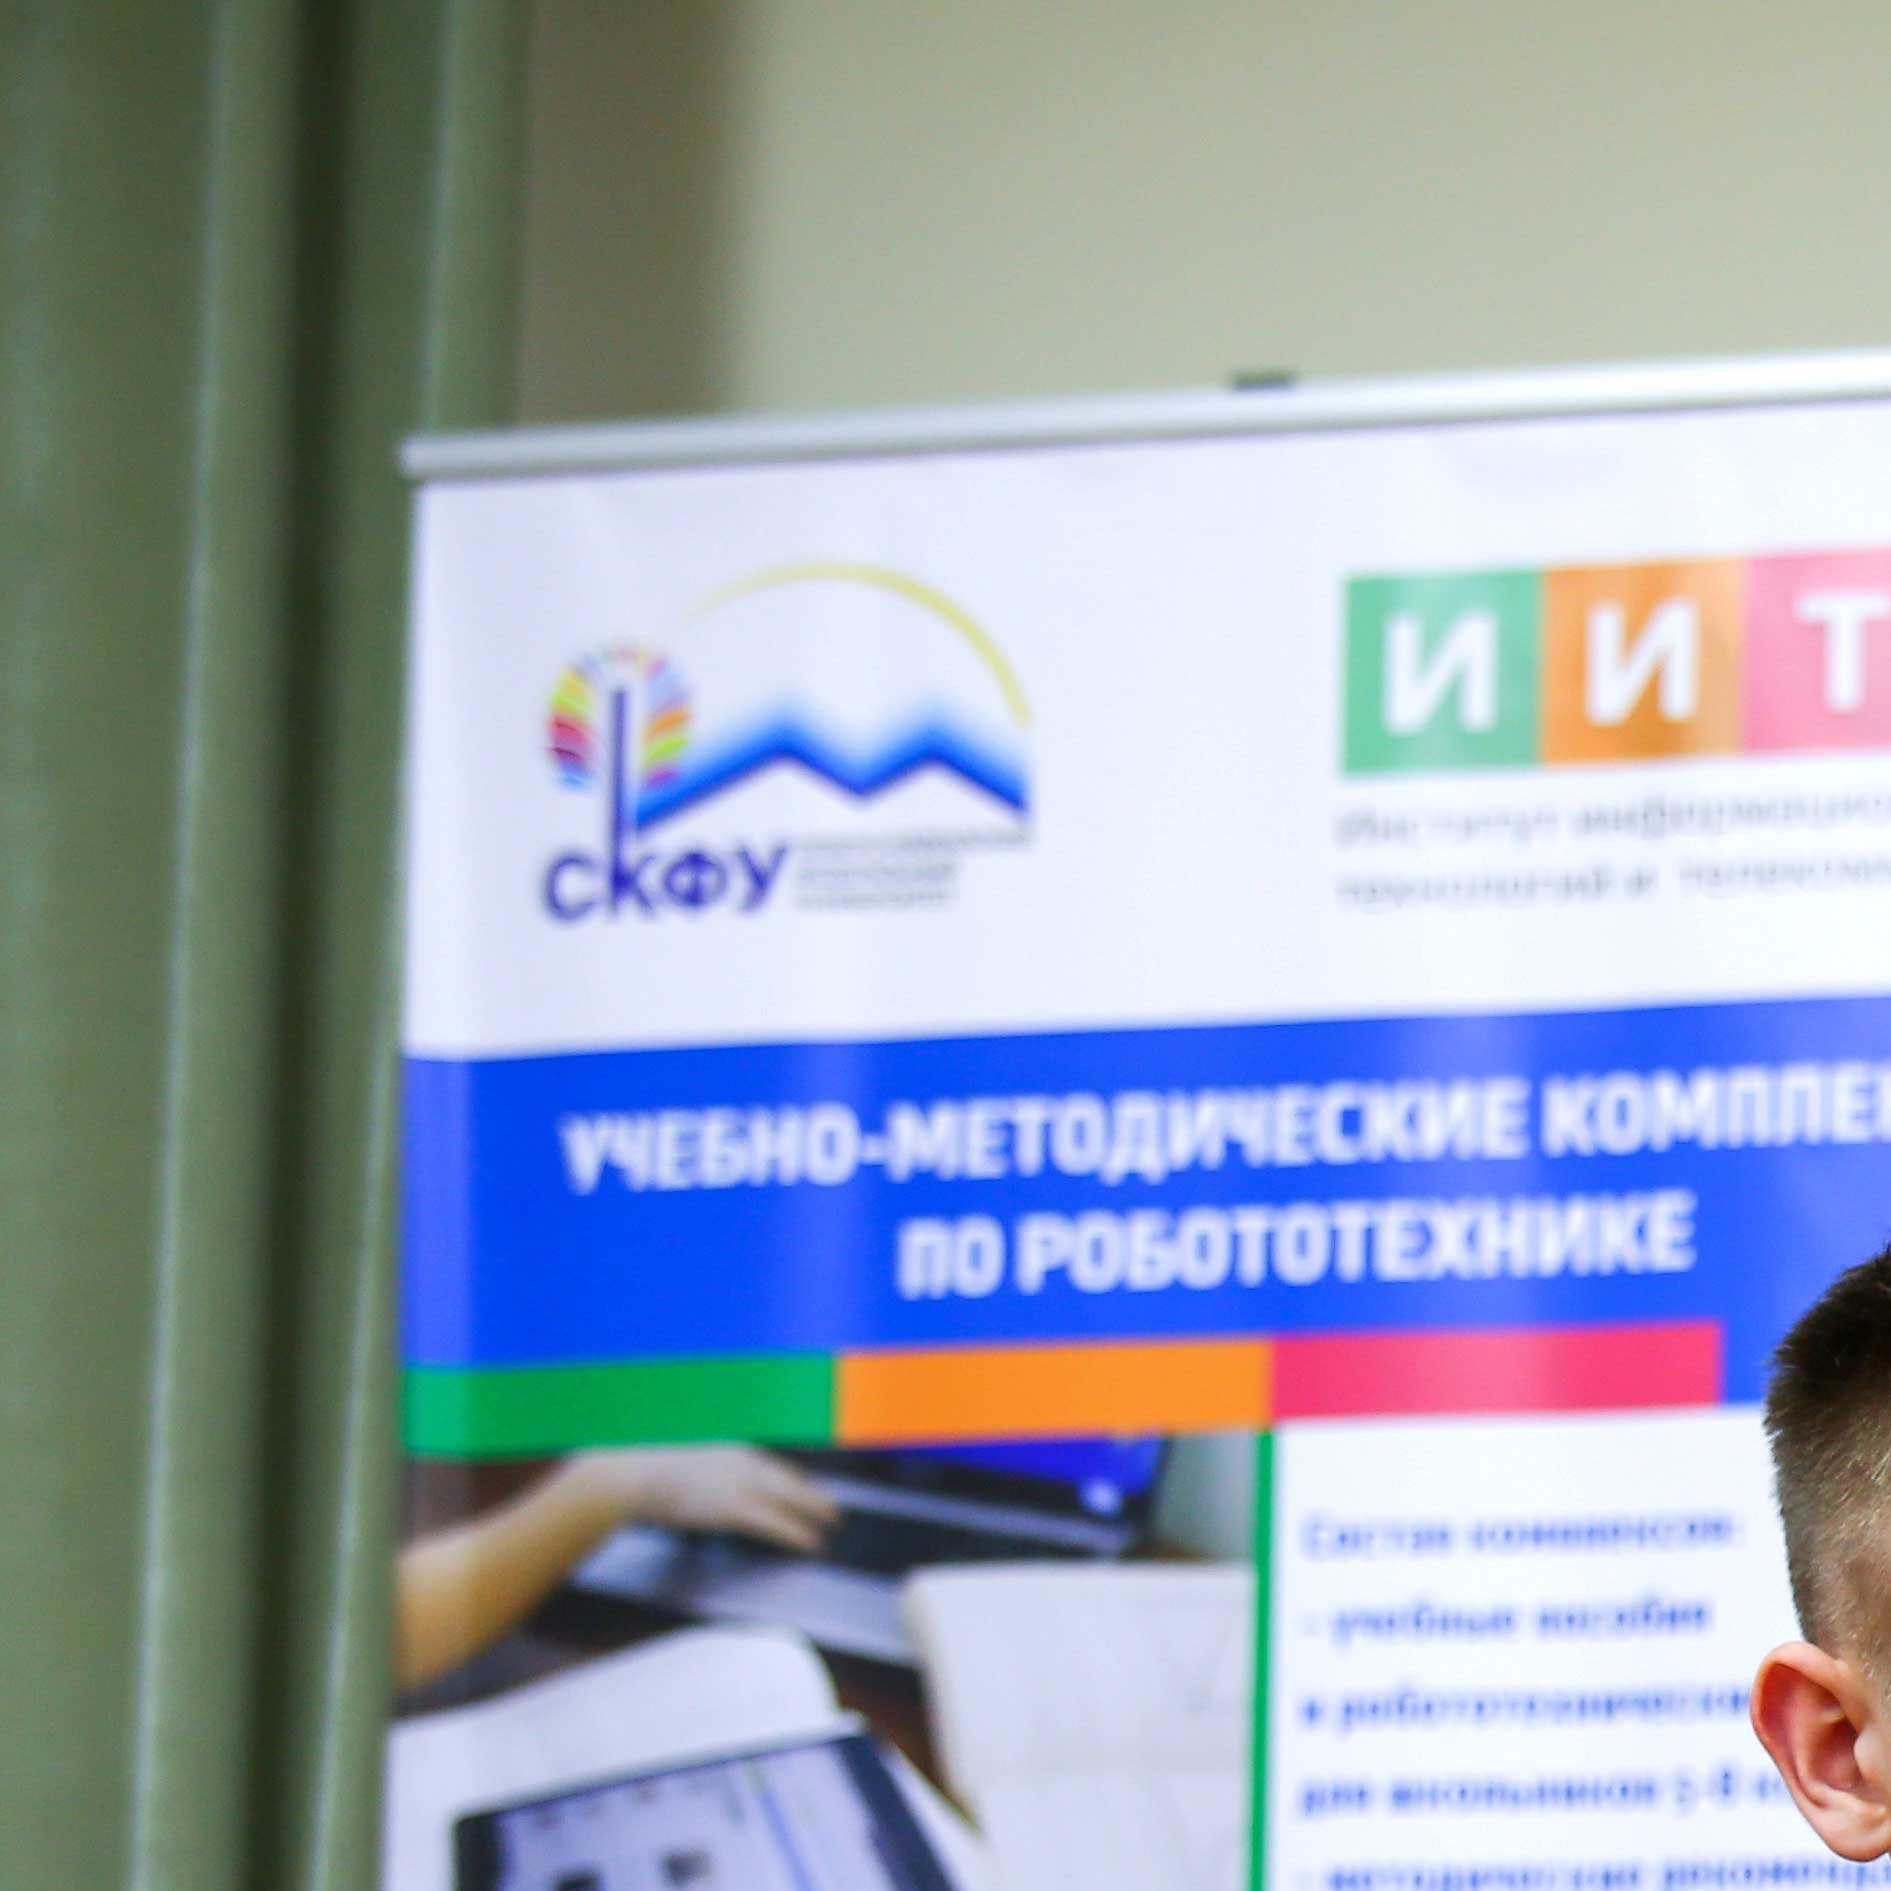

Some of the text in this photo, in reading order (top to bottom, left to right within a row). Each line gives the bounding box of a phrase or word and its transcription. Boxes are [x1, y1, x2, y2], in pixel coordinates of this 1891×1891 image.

[560, 1078, 1530, 1194] УЧЕБНО-МЕТОДИЧЕСКИЕ
[900, 1188, 1695, 1299] ПО РОБОТОТЕХНИКЕ
